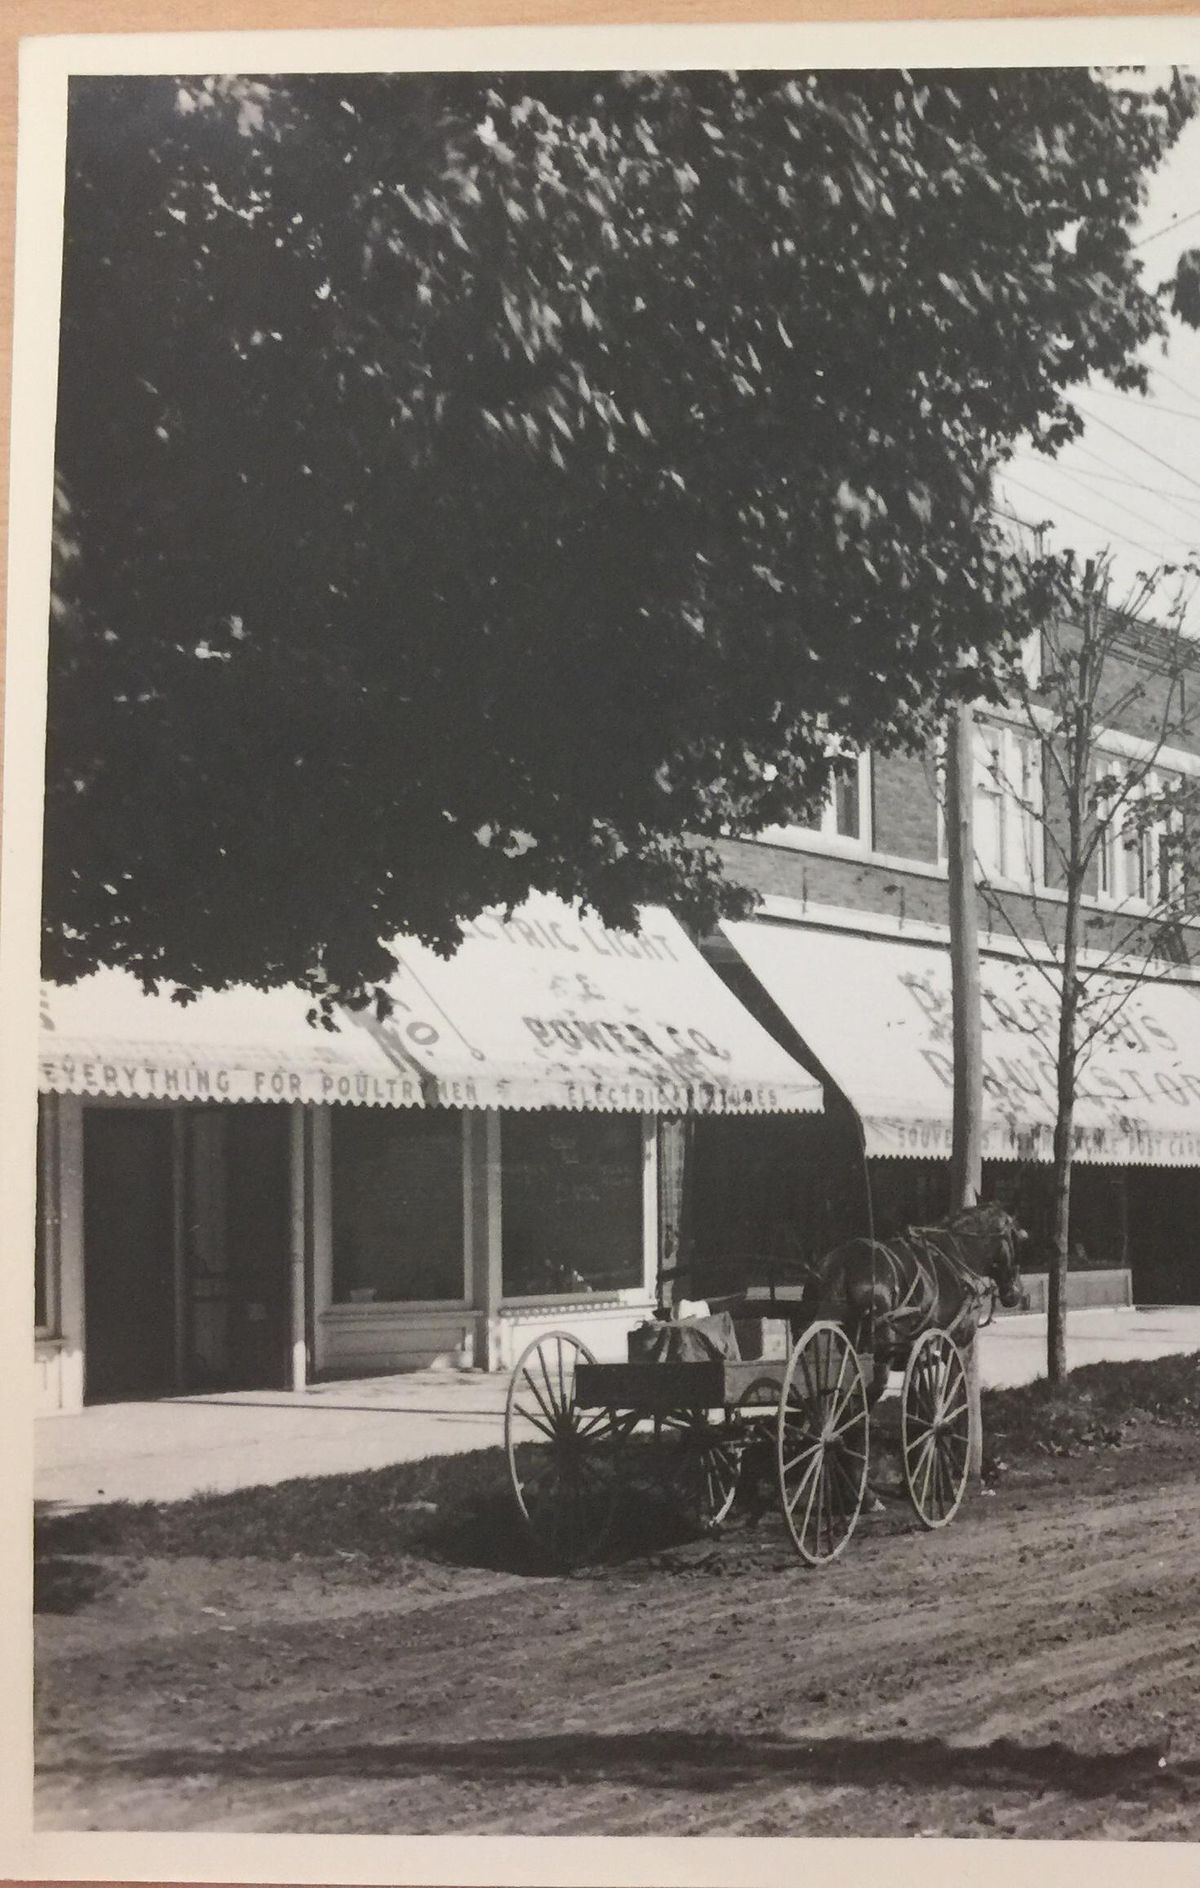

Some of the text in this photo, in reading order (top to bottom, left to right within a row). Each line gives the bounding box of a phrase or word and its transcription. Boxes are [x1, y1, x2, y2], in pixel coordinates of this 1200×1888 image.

[578, 926, 679, 962] LIGHT
[521, 1016, 664, 1058] POWER
[42, 1062, 477, 1101] EVERYTHING FOR POULTRMEN
